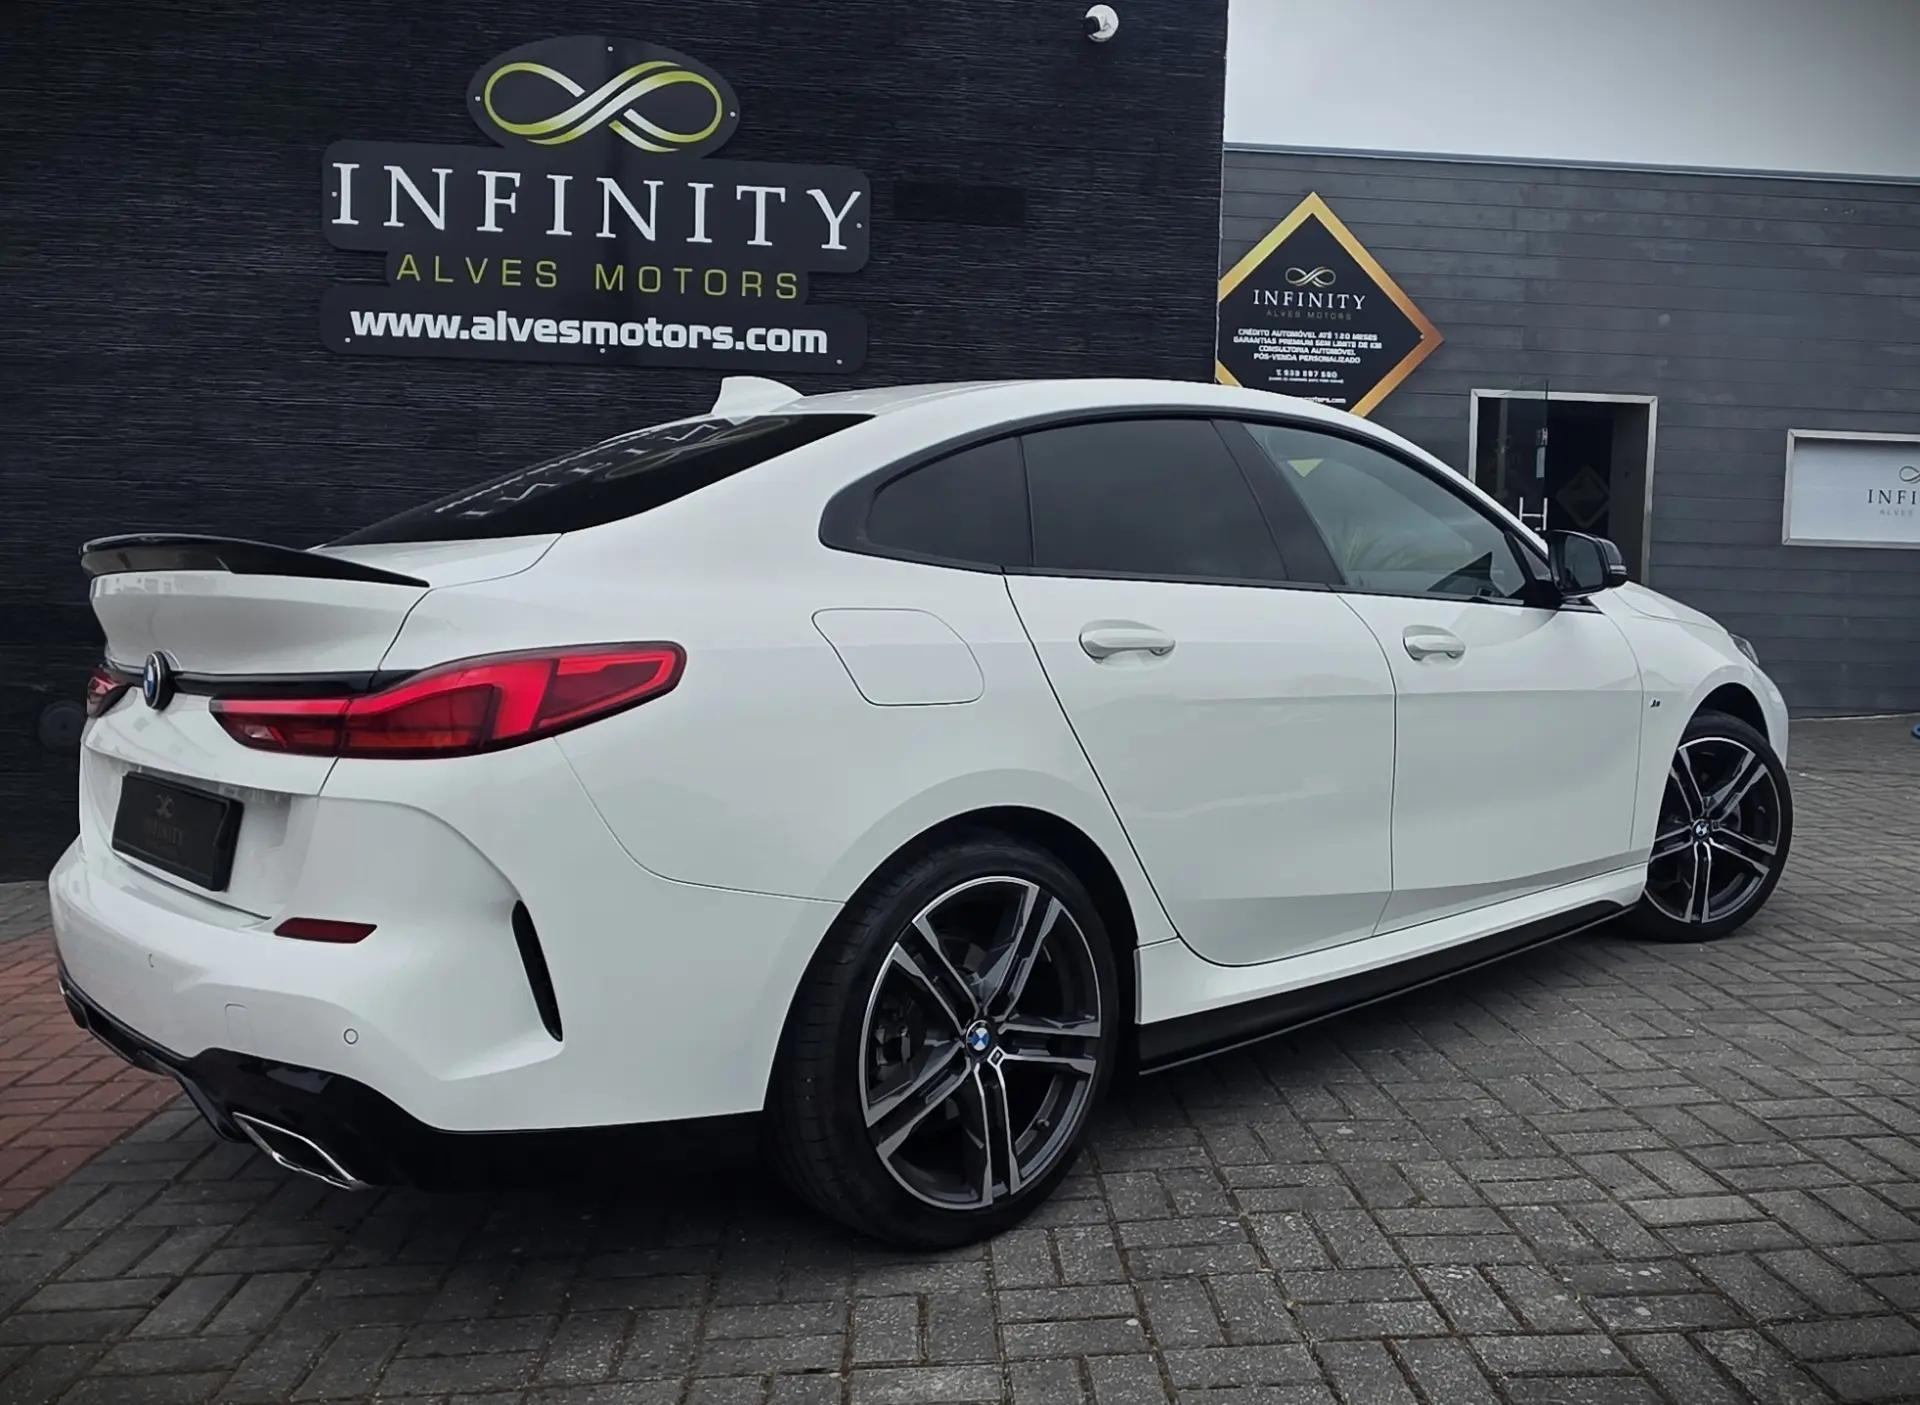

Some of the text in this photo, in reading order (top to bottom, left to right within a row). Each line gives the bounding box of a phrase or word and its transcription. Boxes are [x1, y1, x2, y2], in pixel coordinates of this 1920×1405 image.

[332, 162, 861, 250] INFINITY
[396, 254, 798, 299] ALVES MOTORS
[1253, 289, 1365, 310] INFINITY
[350, 310, 828, 354] www.alvesmotors.com
